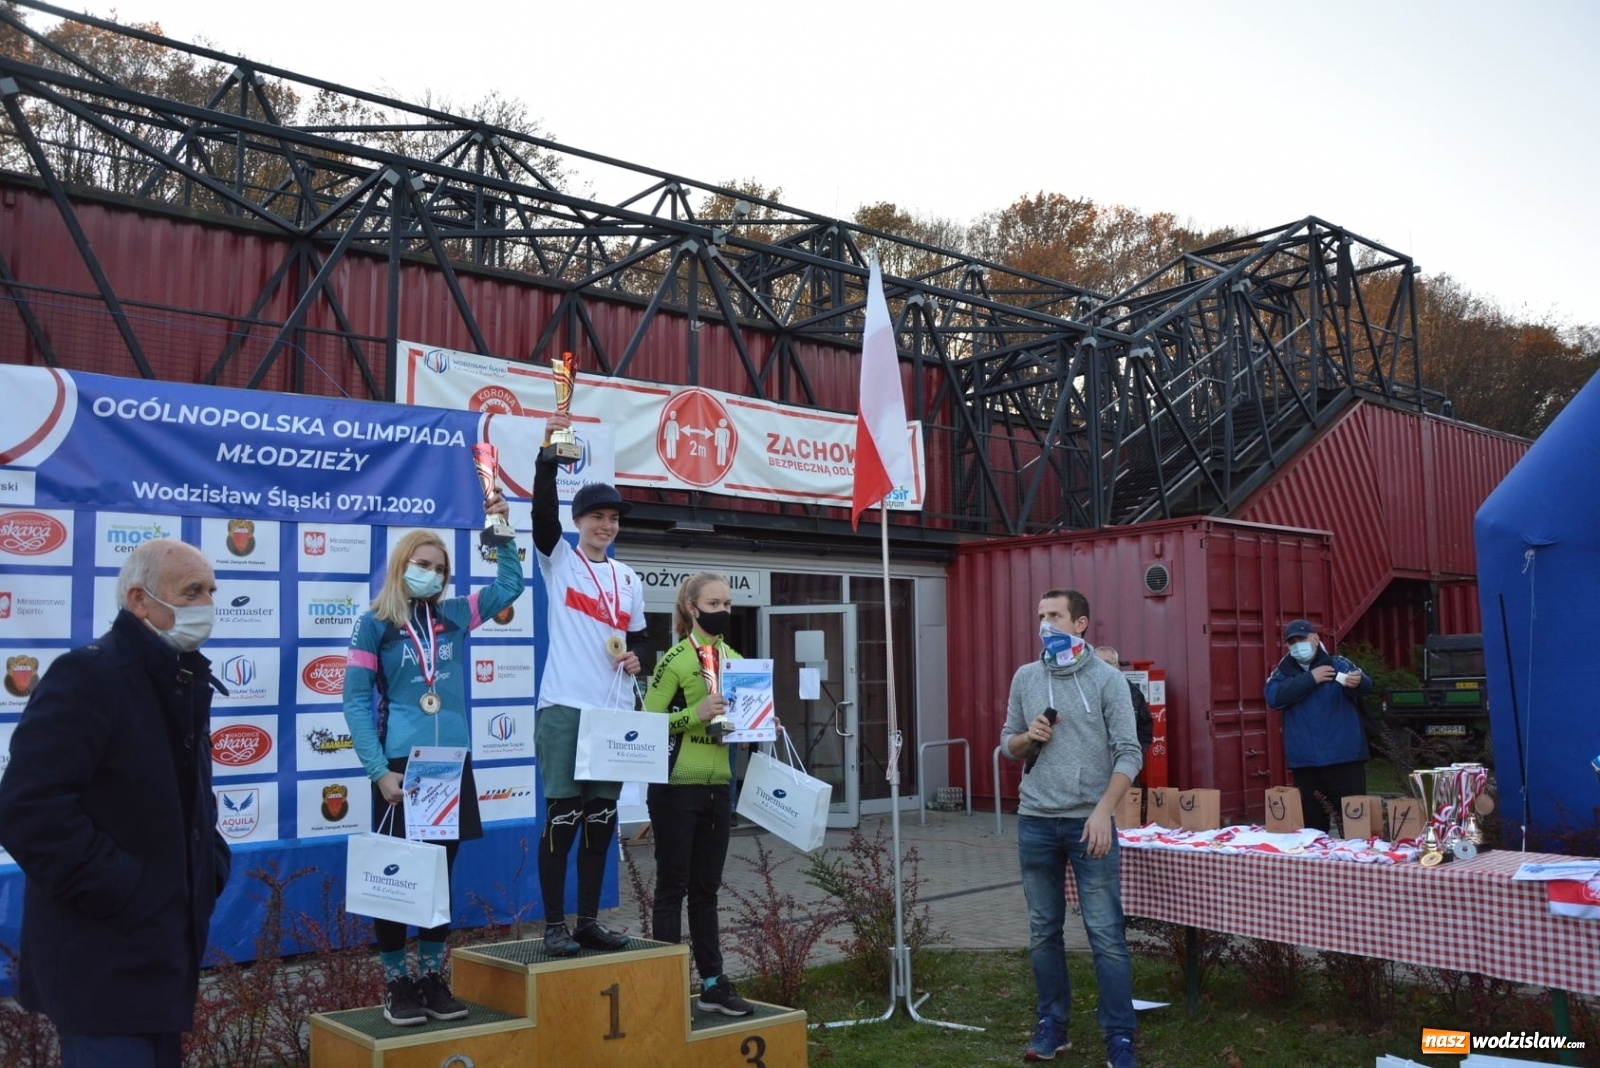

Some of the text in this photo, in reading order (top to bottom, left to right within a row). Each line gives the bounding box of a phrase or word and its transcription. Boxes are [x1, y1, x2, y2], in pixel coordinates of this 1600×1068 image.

[452, 359, 488, 369] WODZISŁAW
[478, 388, 515, 408] KORONA
[93, 397, 466, 447] OGÓLNOPOLSKA OLIMPIADA
[216, 443, 369, 472] MŁODZIEŻY
[689, 440, 707, 459] 2m
[768, 456, 855, 477] BEZPIECZNĄ ODL
[0, 482, 18, 491] ski
[132, 480, 436, 514] Wodzisław Śląski 07.11.2020
[215, 606, 274, 616] imemaster
[308, 603, 360, 616] mosir
[314, 616, 353, 625] centrum
[310, 663, 346, 679] skaw
[214, 734, 259, 750] skawa
[607, 739, 656, 751] Timemaster
[511, 790, 531, 798] KOP
[755, 785, 800, 818] Timemaster
[222, 817, 255, 827] AQUILA
[363, 871, 418, 890] Timemaster
[600, 983, 627, 1041] 1
